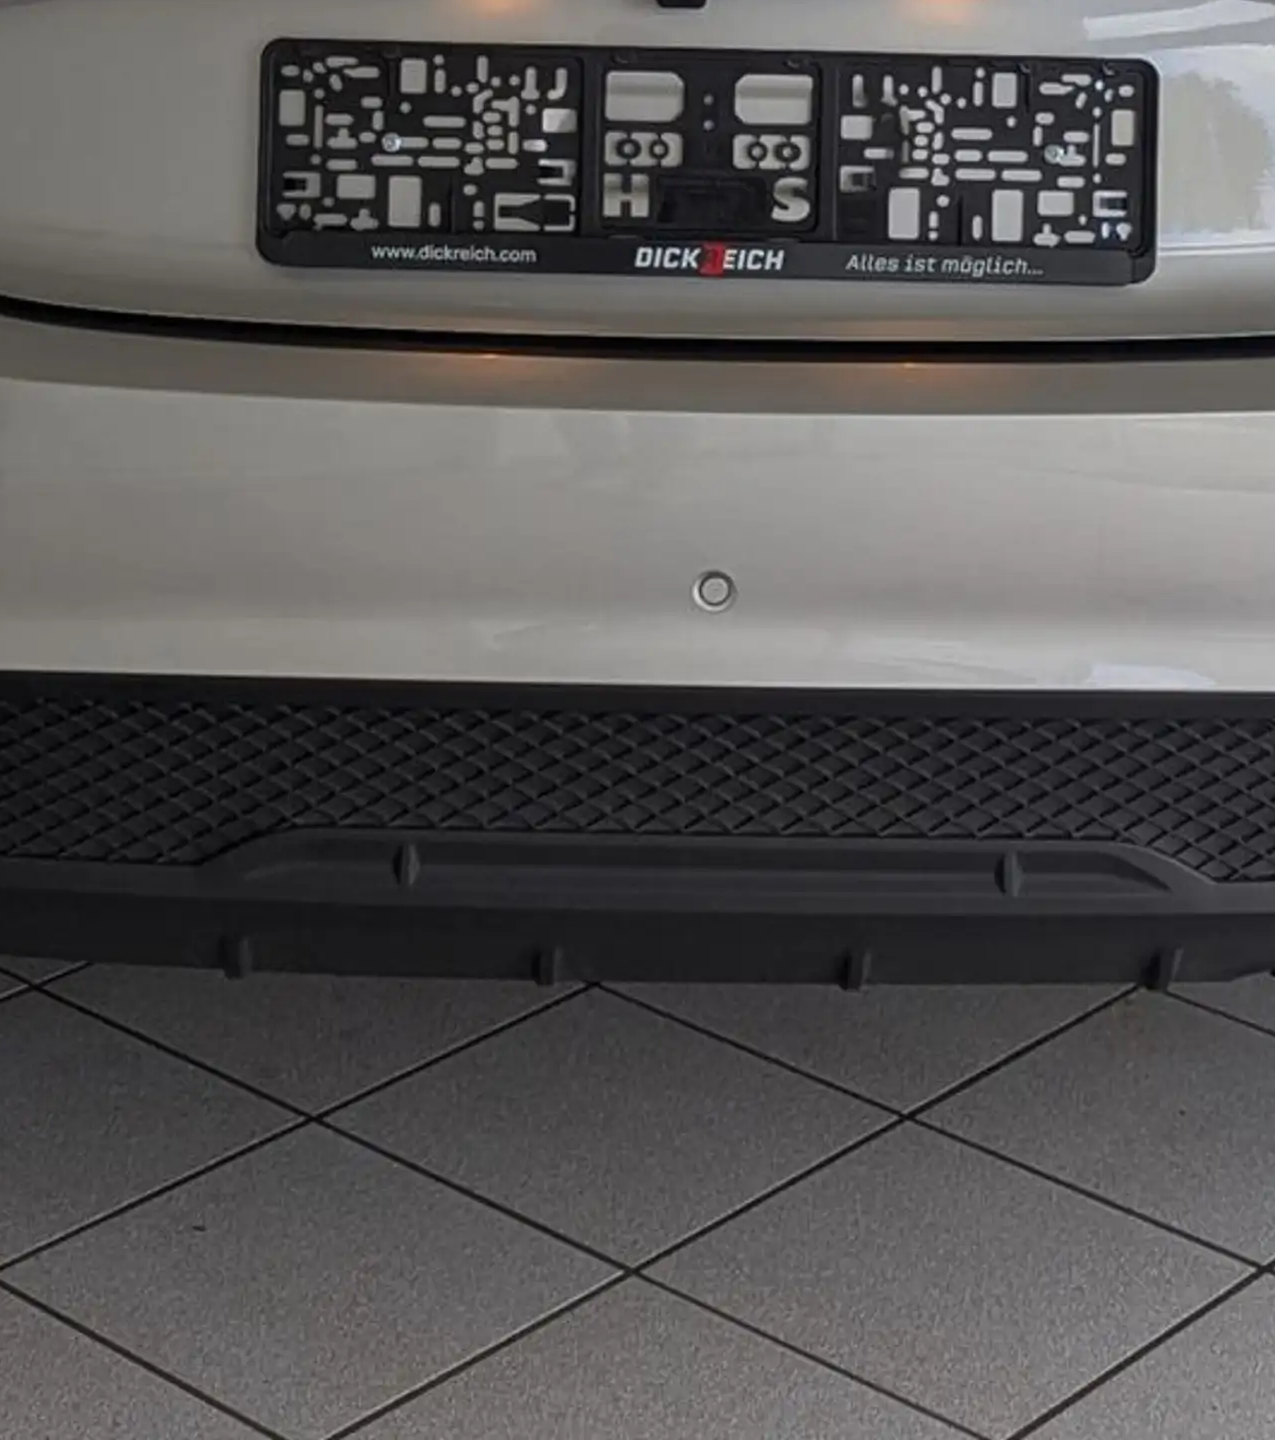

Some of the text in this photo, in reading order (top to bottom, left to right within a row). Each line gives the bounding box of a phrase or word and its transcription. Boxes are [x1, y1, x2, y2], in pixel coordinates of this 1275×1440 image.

[370, 245, 538, 263] www.dickreich.com
[845, 254, 900, 272] Alles
[903, 254, 936, 273] ist
